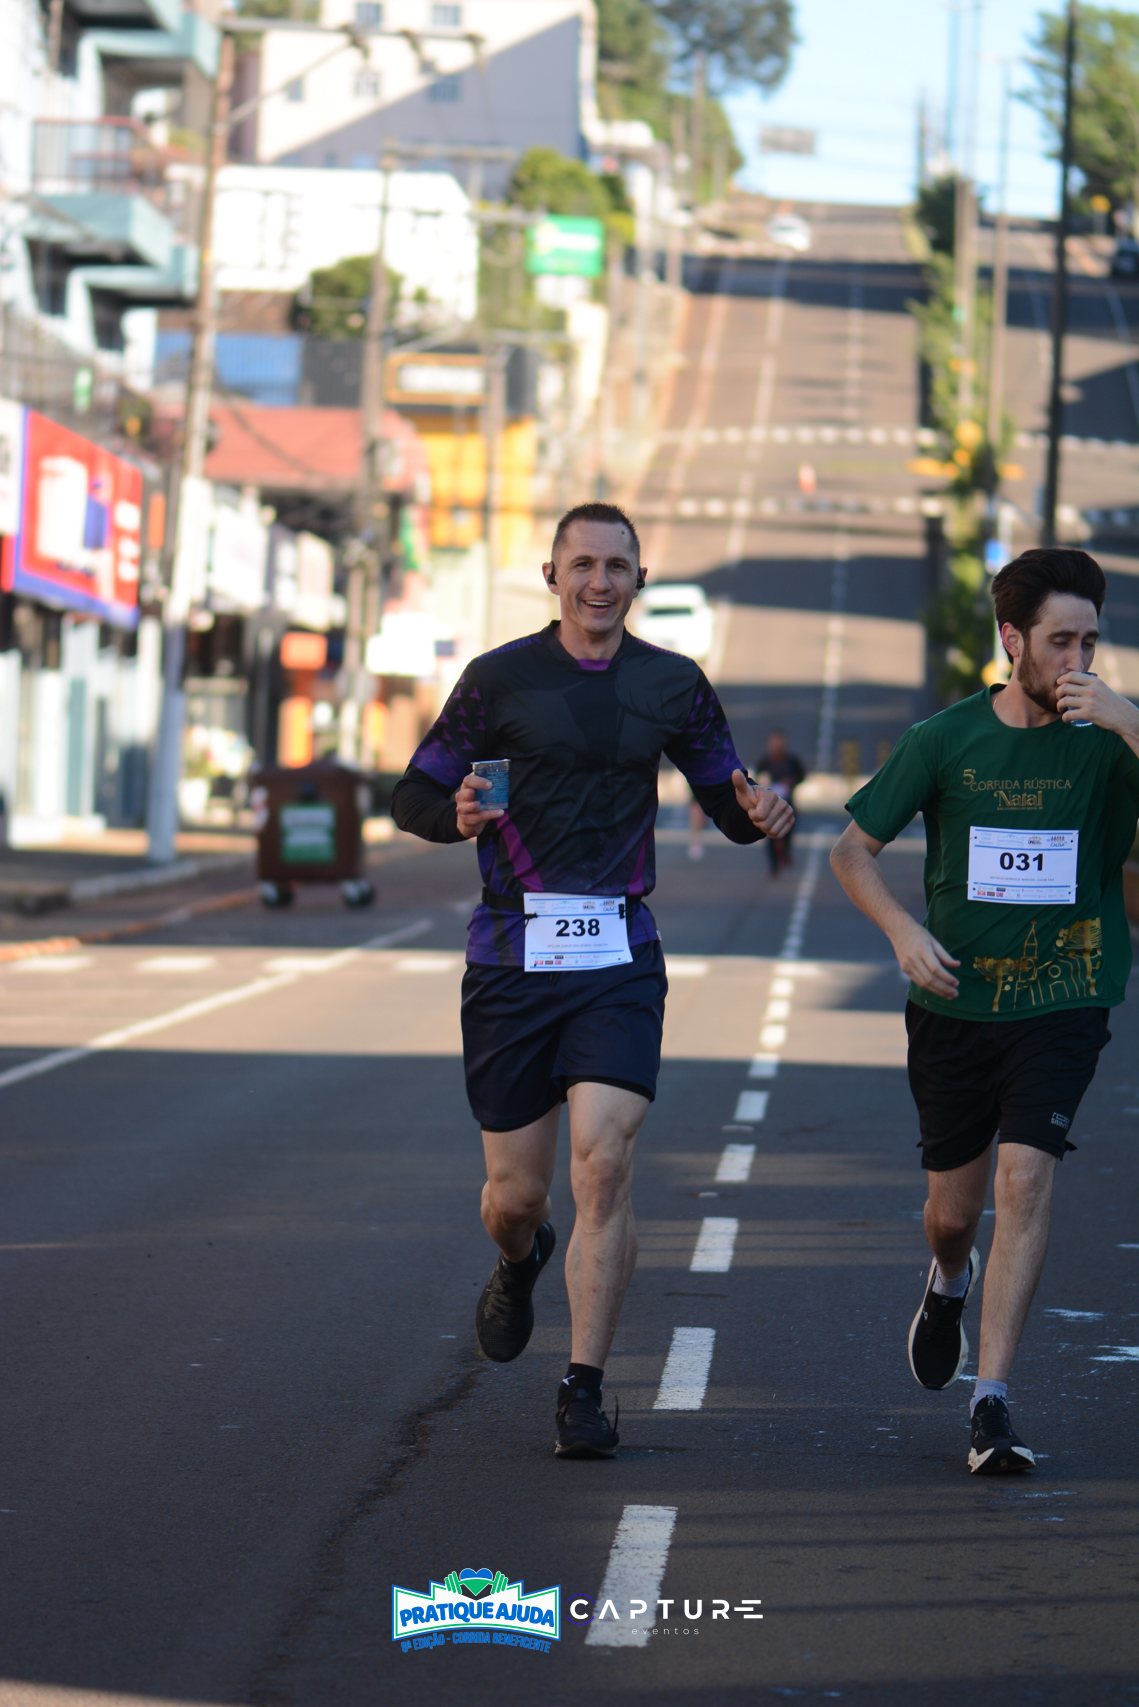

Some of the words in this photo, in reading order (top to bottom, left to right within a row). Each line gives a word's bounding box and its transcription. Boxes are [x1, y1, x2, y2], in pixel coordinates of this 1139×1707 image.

[970, 780, 1021, 792] CORRIDA
[1023, 777, 1072, 790] RÚSTICA
[993, 790, 1043, 806] Natal
[999, 852, 1044, 871] 031
[555, 918, 601, 937] 238
